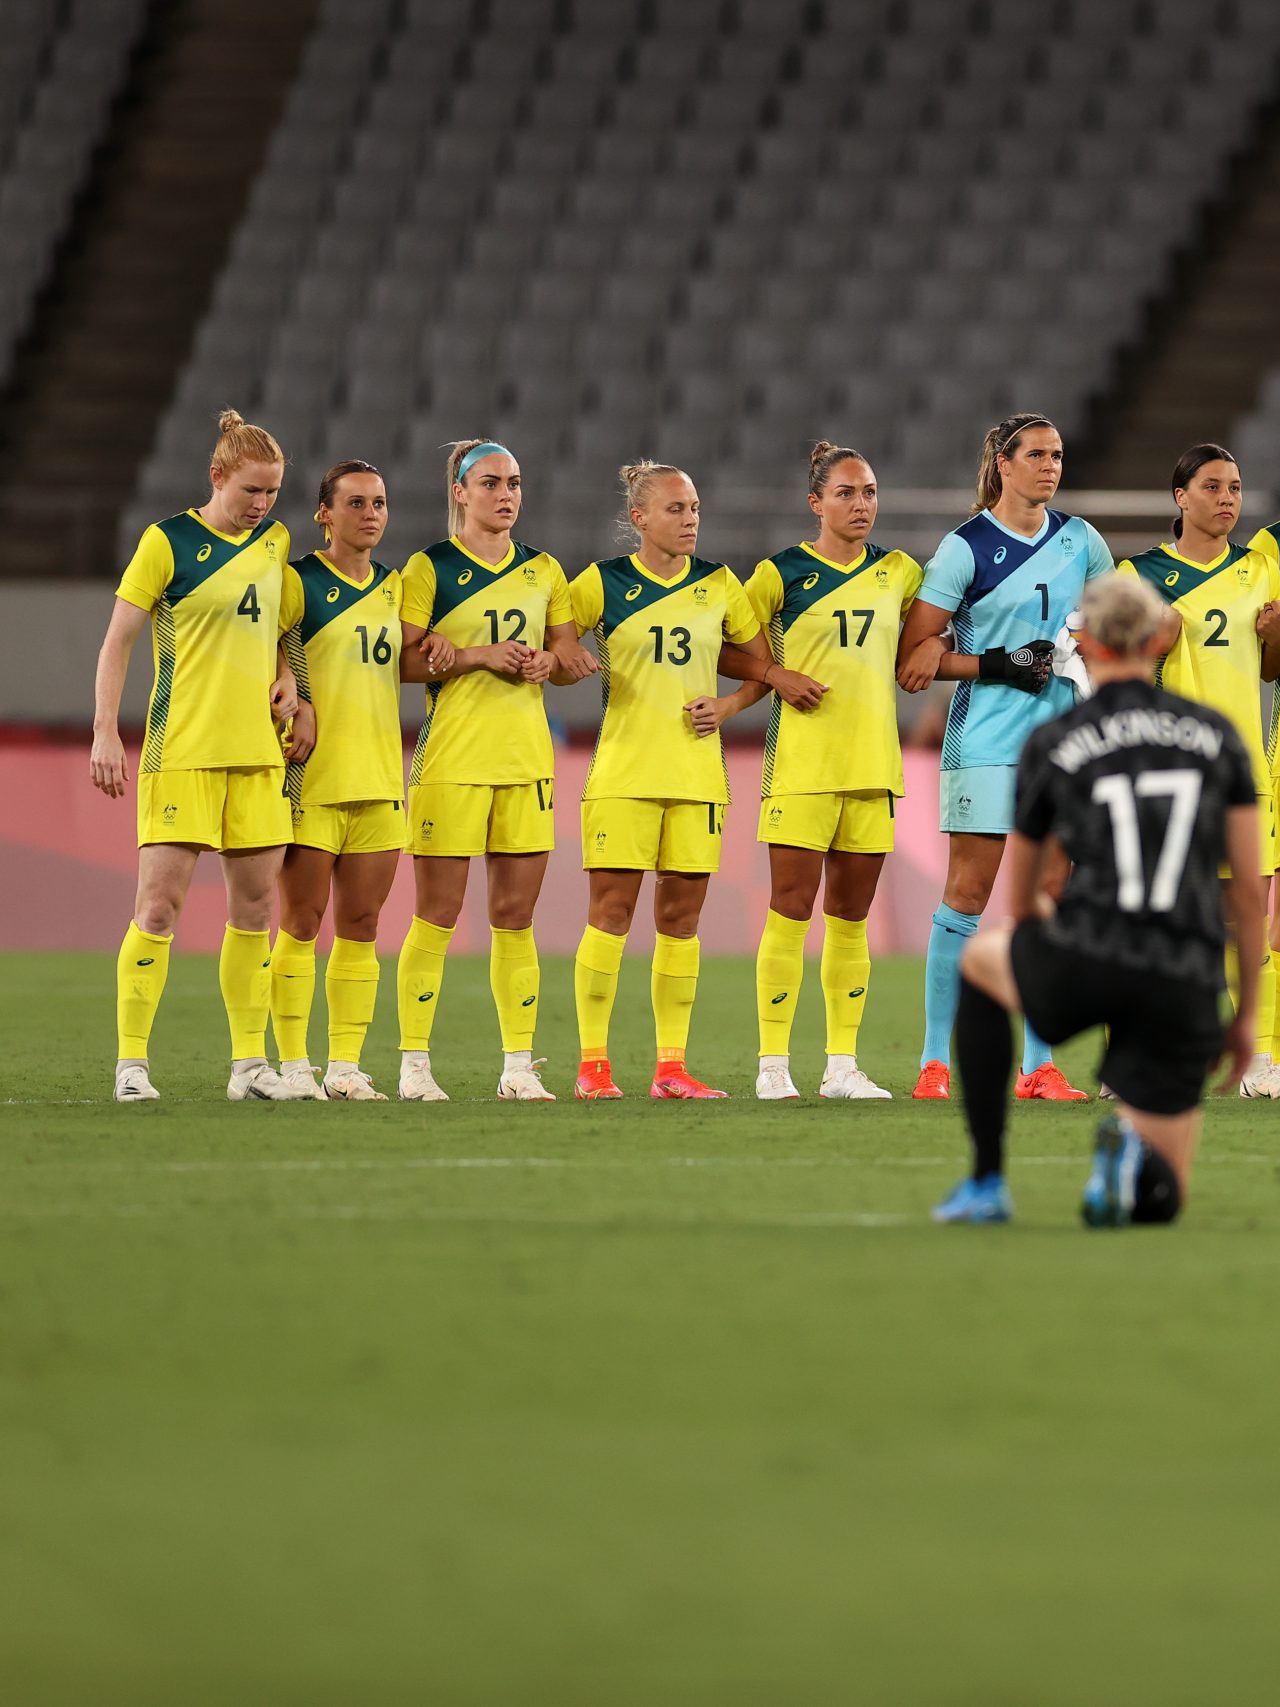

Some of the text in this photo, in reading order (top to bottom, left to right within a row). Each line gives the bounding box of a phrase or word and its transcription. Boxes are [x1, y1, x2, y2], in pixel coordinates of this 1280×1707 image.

[237, 584, 261, 623] 4
[1035, 583, 1049, 621] 1
[355, 625, 392, 665] 16
[484, 609, 527, 645] 12
[649, 625, 692, 666] 13
[832, 609, 875, 648] 17
[1204, 609, 1229, 647] 2
[1093, 770, 1202, 911] 17
